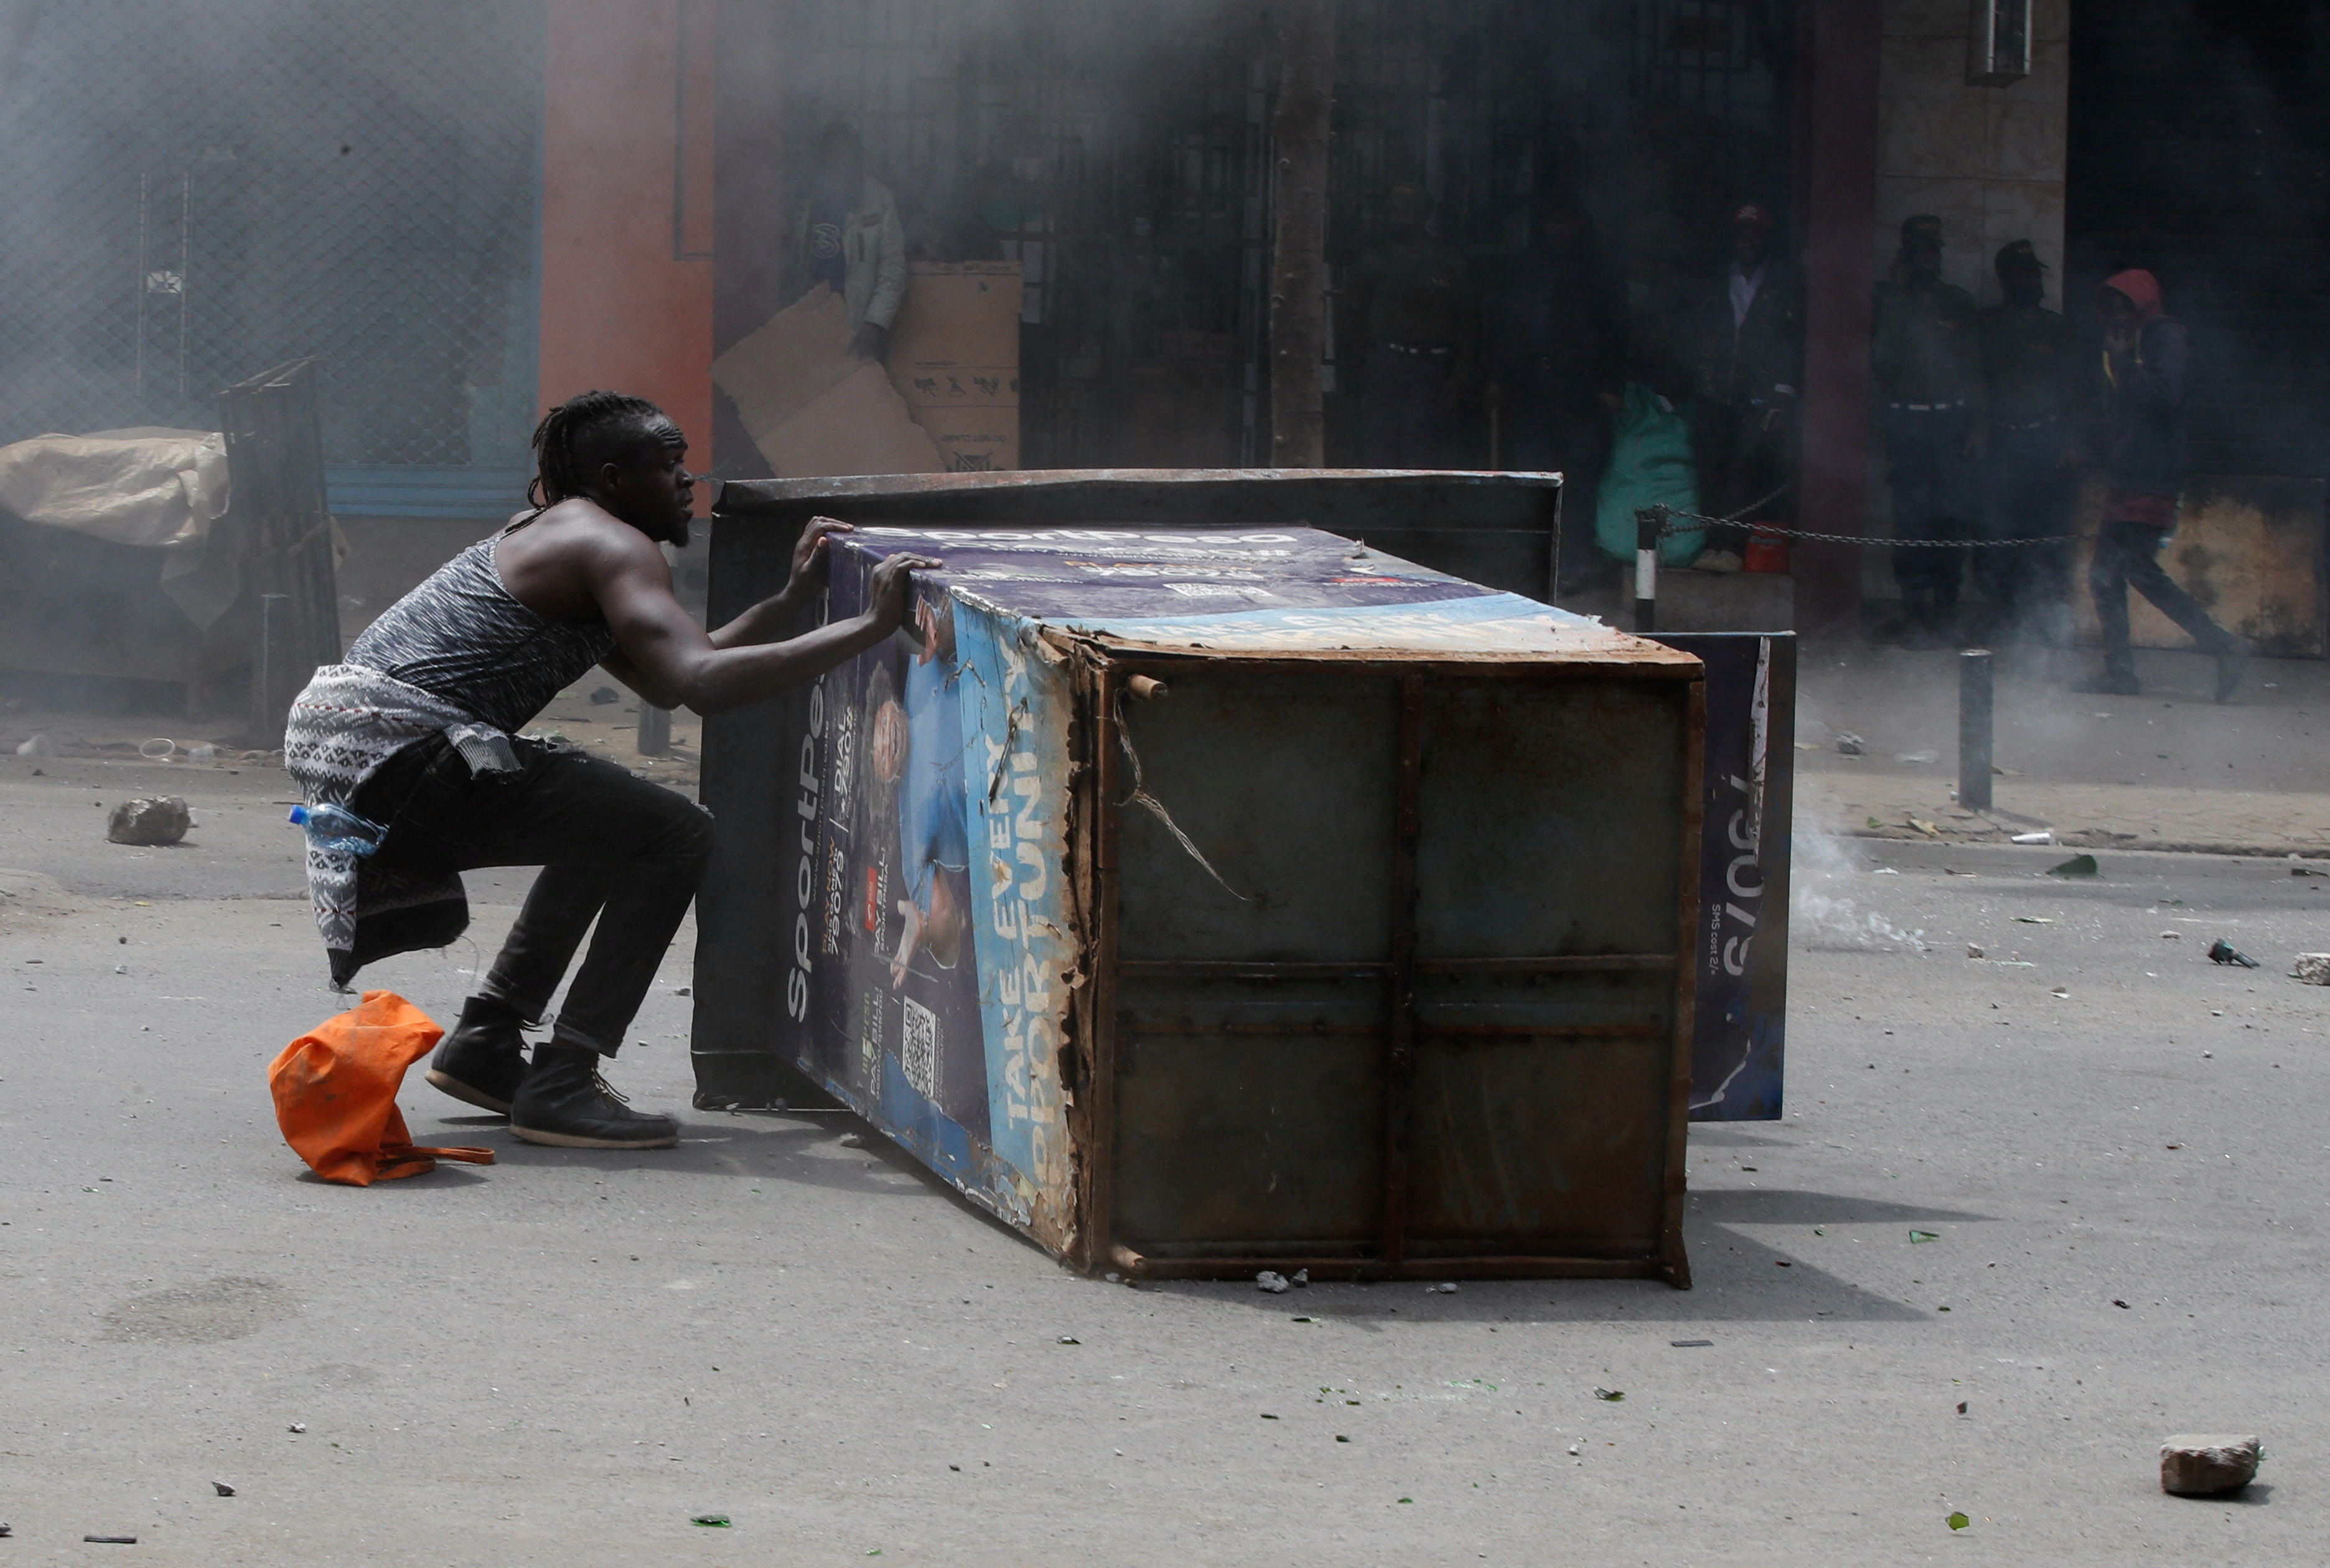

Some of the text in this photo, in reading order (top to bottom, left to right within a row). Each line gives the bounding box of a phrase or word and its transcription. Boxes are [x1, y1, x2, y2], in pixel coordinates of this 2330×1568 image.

[861, 527, 1298, 543] SportPesa
[1127, 621, 1281, 636] TAKE
[835, 714, 846, 793] DIAL
[787, 586, 830, 1023] SportPea
[826, 836, 835, 891] NOW
[876, 846, 885, 905] BILL:
[831, 850, 843, 955] 79079
[986, 733, 1027, 1129] TAKE EVERY
[999, 635, 1058, 1186] PPORTUNITY
[1708, 903, 1721, 976] SMS cost 2/=
